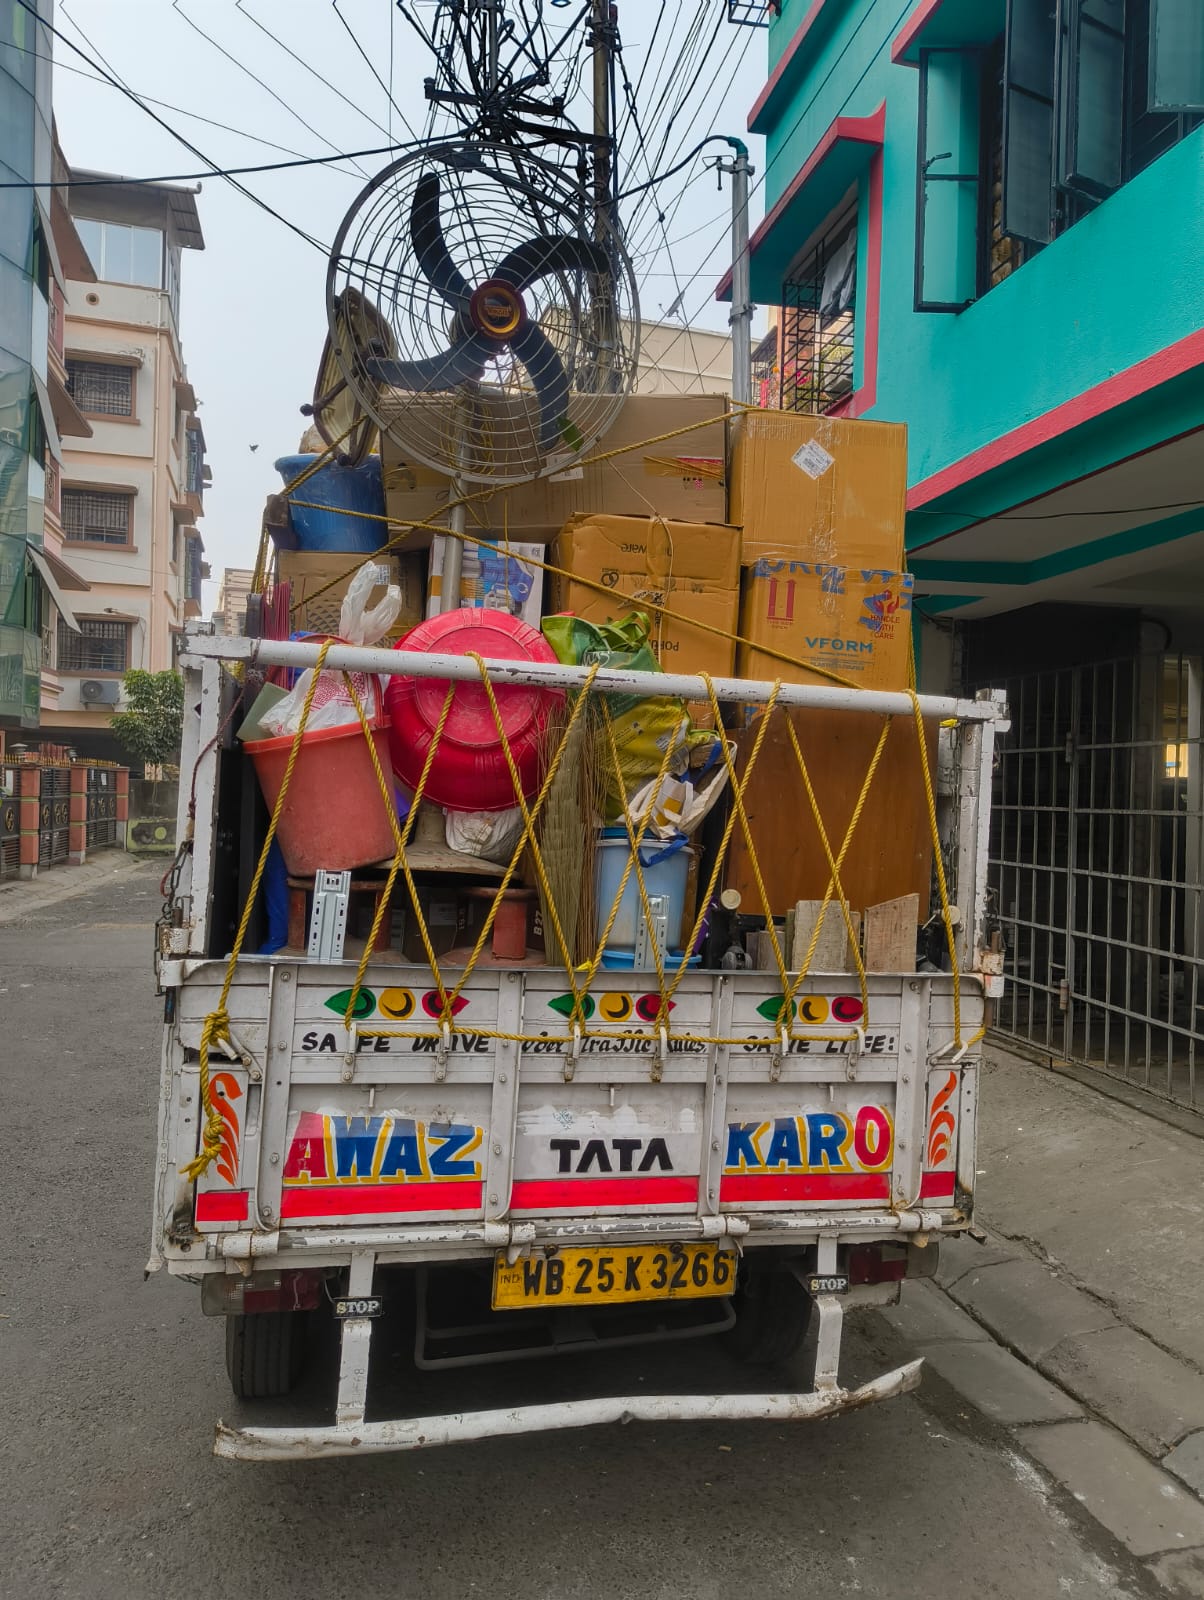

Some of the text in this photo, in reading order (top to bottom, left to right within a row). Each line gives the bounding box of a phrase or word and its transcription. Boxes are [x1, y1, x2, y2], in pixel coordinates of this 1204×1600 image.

[805, 636, 873, 654] VFORM
[283, 1110, 482, 1184] AWAZ
[550, 1137, 673, 1173] TATA
[725, 1105, 893, 1174] KARO
[651, 1251, 730, 1290] 3266
[810, 1278, 848, 1291] STOP
[336, 1300, 380, 1314] STOP
